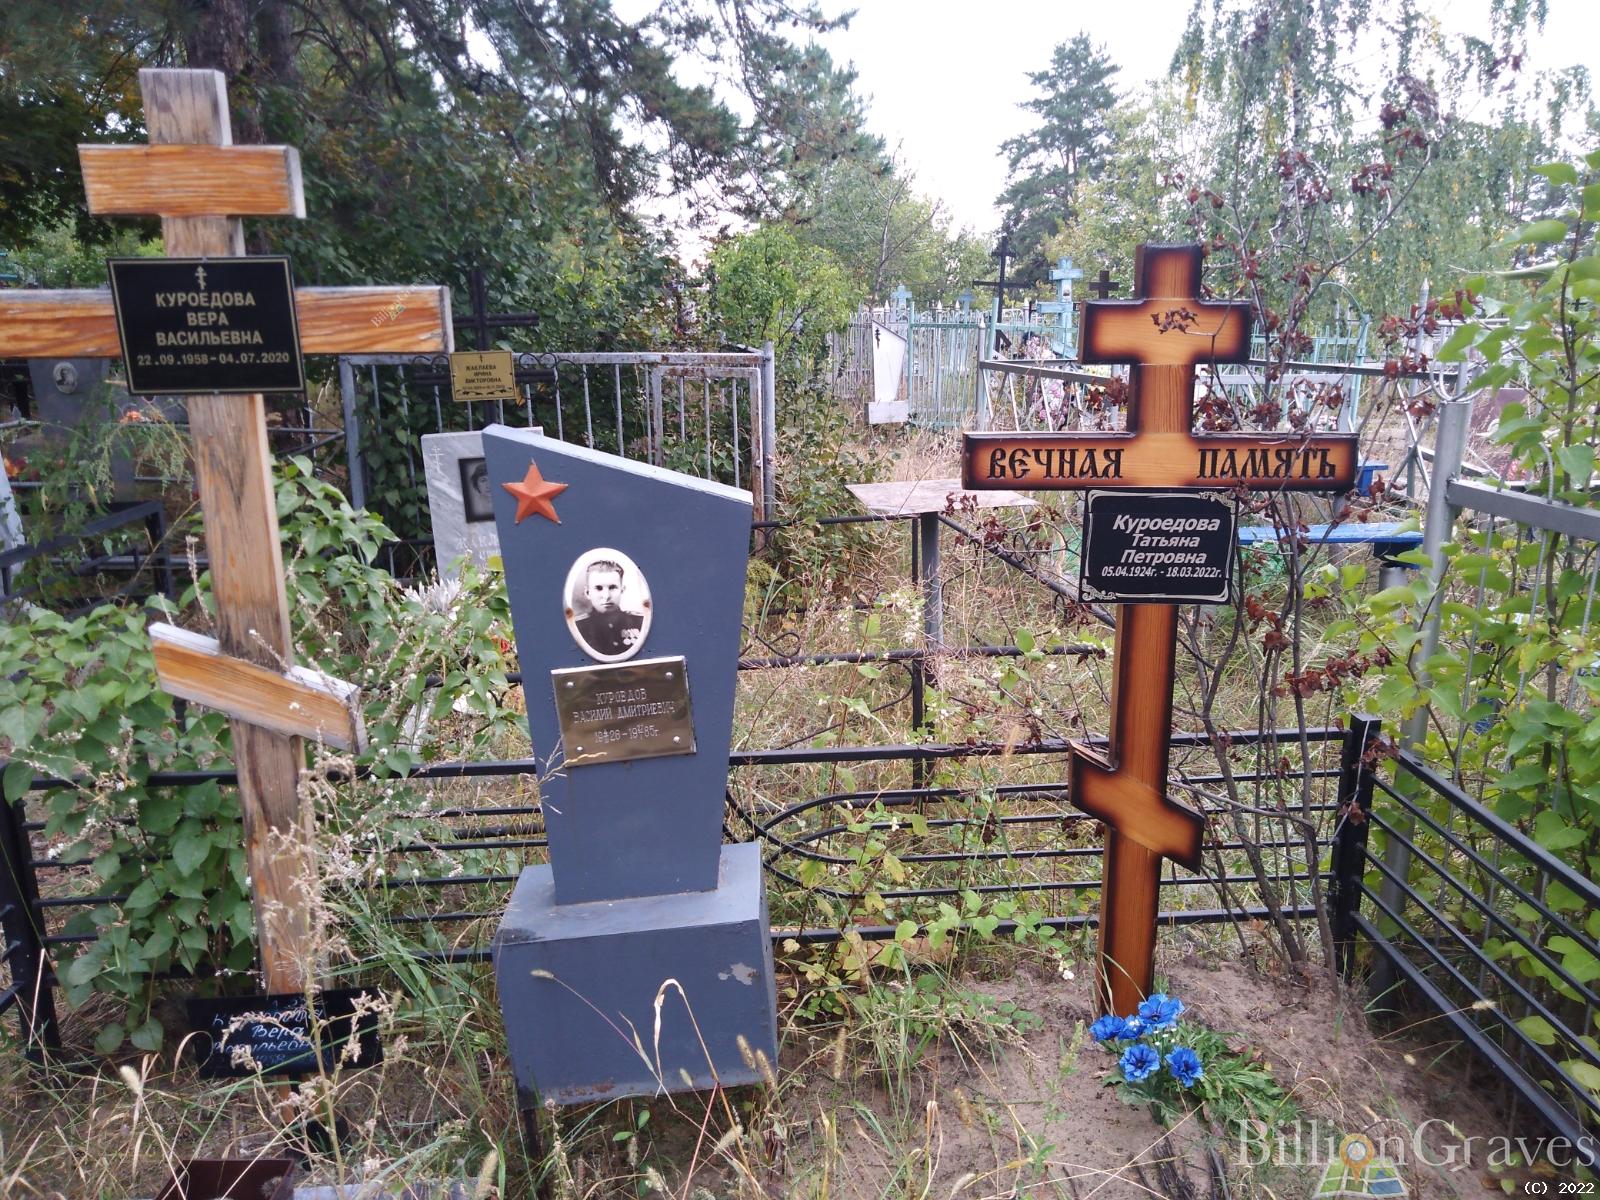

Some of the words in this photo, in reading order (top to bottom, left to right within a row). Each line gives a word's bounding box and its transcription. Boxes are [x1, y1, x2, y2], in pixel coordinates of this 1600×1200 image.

[155, 292, 256, 309] КУРОЕДОВА
[186, 312, 229, 326] ВЕРА
[156, 331, 263, 346] ВАСИЛЬЕВНА
[986, 447, 1125, 480] ВЕЧНАЯ
[1196, 447, 1336, 480] ПАМЯТЬ
[1113, 514, 1221, 534] Куроедова
[1131, 533, 1201, 548] Татьяна
[1120, 549, 1207, 566] Петровна
[1101, 566, 1158, 577] 05.04.1924г.
[1166, 567, 1222, 578] 18.03.2022г.
[595, 688, 647, 705] КУРОЕДОВ
[573, 707, 613, 723] ВАСИЛИЙ
[618, 701, 675, 719] ДМИТРИЕВИЧ
